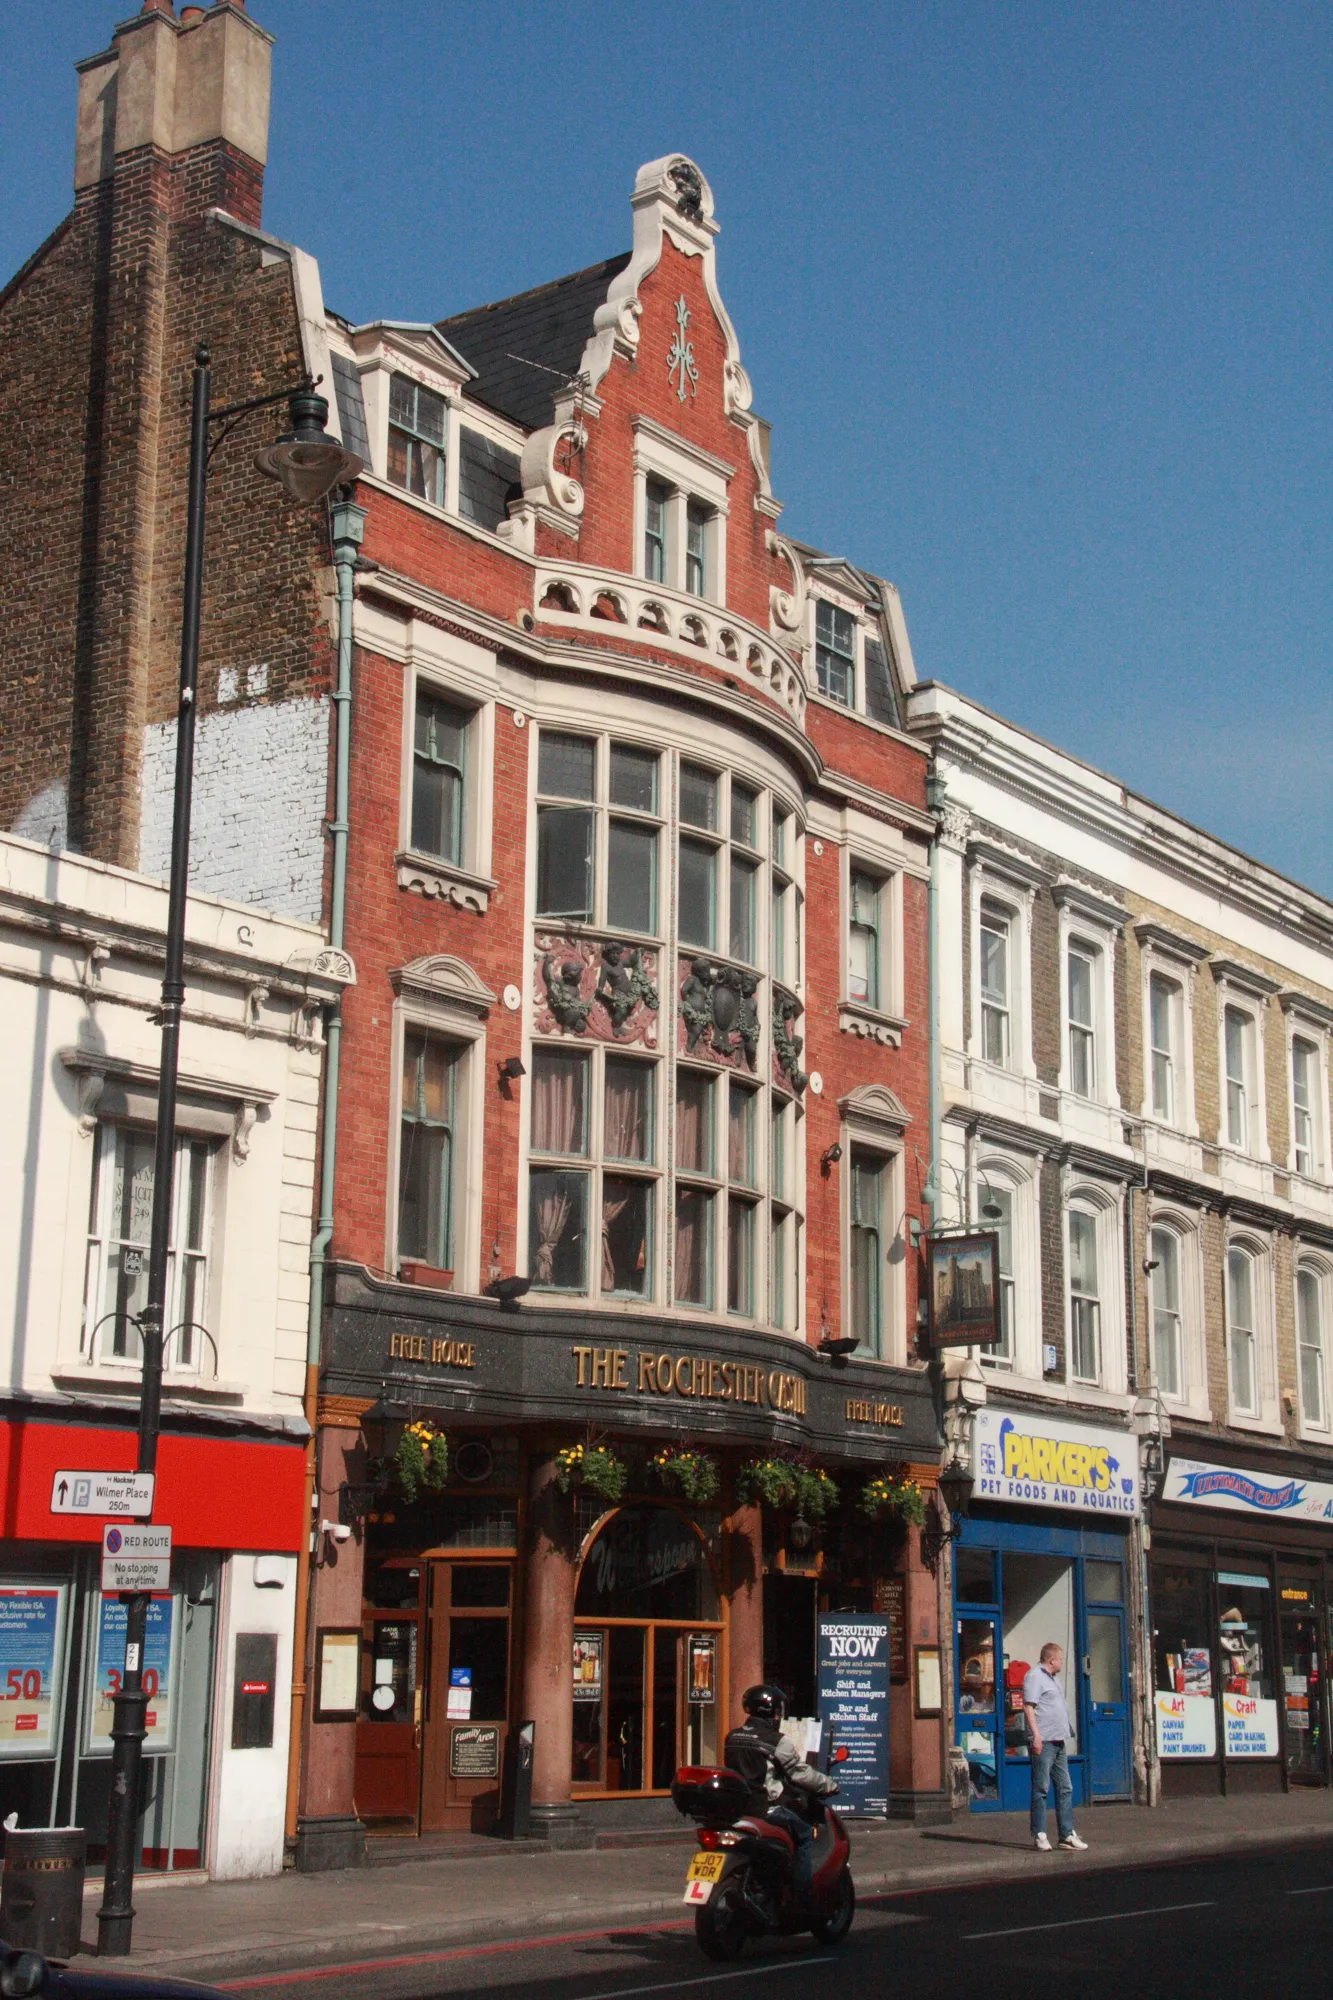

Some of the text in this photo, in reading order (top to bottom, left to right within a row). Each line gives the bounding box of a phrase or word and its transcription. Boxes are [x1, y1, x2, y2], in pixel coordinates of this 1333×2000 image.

[389, 1333, 476, 1366] FREE HOUSE
[573, 1346, 807, 1415] THE ROCHESTER CASTLE
[845, 1400, 905, 1426] FREE HOUSE
[1004, 1432, 1111, 1492] PARKER'S
[113, 1477, 136, 1485] Hackney
[96, 1486, 149, 1499] Wilmer Place
[981, 1479, 1135, 1511] PET FOODS AND AQUATICS
[1196, 1474, 1292, 1507] ULTIMATE CRAFT
[108, 1501, 130, 1511] 250m
[124, 1536, 169, 1547] RED ROUTE
[114, 1562, 126, 1573] No
[116, 1576, 123, 1585] at
[140, 1576, 156, 1585] time
[1281, 1588, 1308, 1600] entrance
[105, 1604, 127, 1612] Loyalty
[0, 1611, 22, 1619] xclusive
[37, 1611, 47, 1619] for
[153, 1613, 163, 1621] for
[821, 1625, 888, 1637] RECRUITING
[829, 1636, 880, 1657] NOW
[838, 1660, 851, 1668] jobs
[836, 1680, 871, 1689] Shift and
[821, 1689, 886, 1700] Kitchen Managers
[838, 1704, 869, 1713] Bar and
[1172, 1698, 1185, 1712] Art
[1236, 1699, 1257, 1714] Craft
[829, 1712, 878, 1721] Kitchen Staff
[1162, 1720, 1184, 1729] CANVAS
[1228, 1720, 1245, 1729] PAPER
[455, 1728, 495, 1743] Family Area
[1163, 1732, 1183, 1740] PAINTS
[1229, 1732, 1265, 1740] CARD MAKING
[1163, 1744, 1206, 1753] PAINT BRUSHES
[1235, 1744, 1250, 1752] MUCH
[1252, 1744, 1266, 1752] MORE
[693, 1853, 723, 1866] LJ07
[694, 1866, 717, 1878] WDR
[690, 1882, 704, 1899] L
